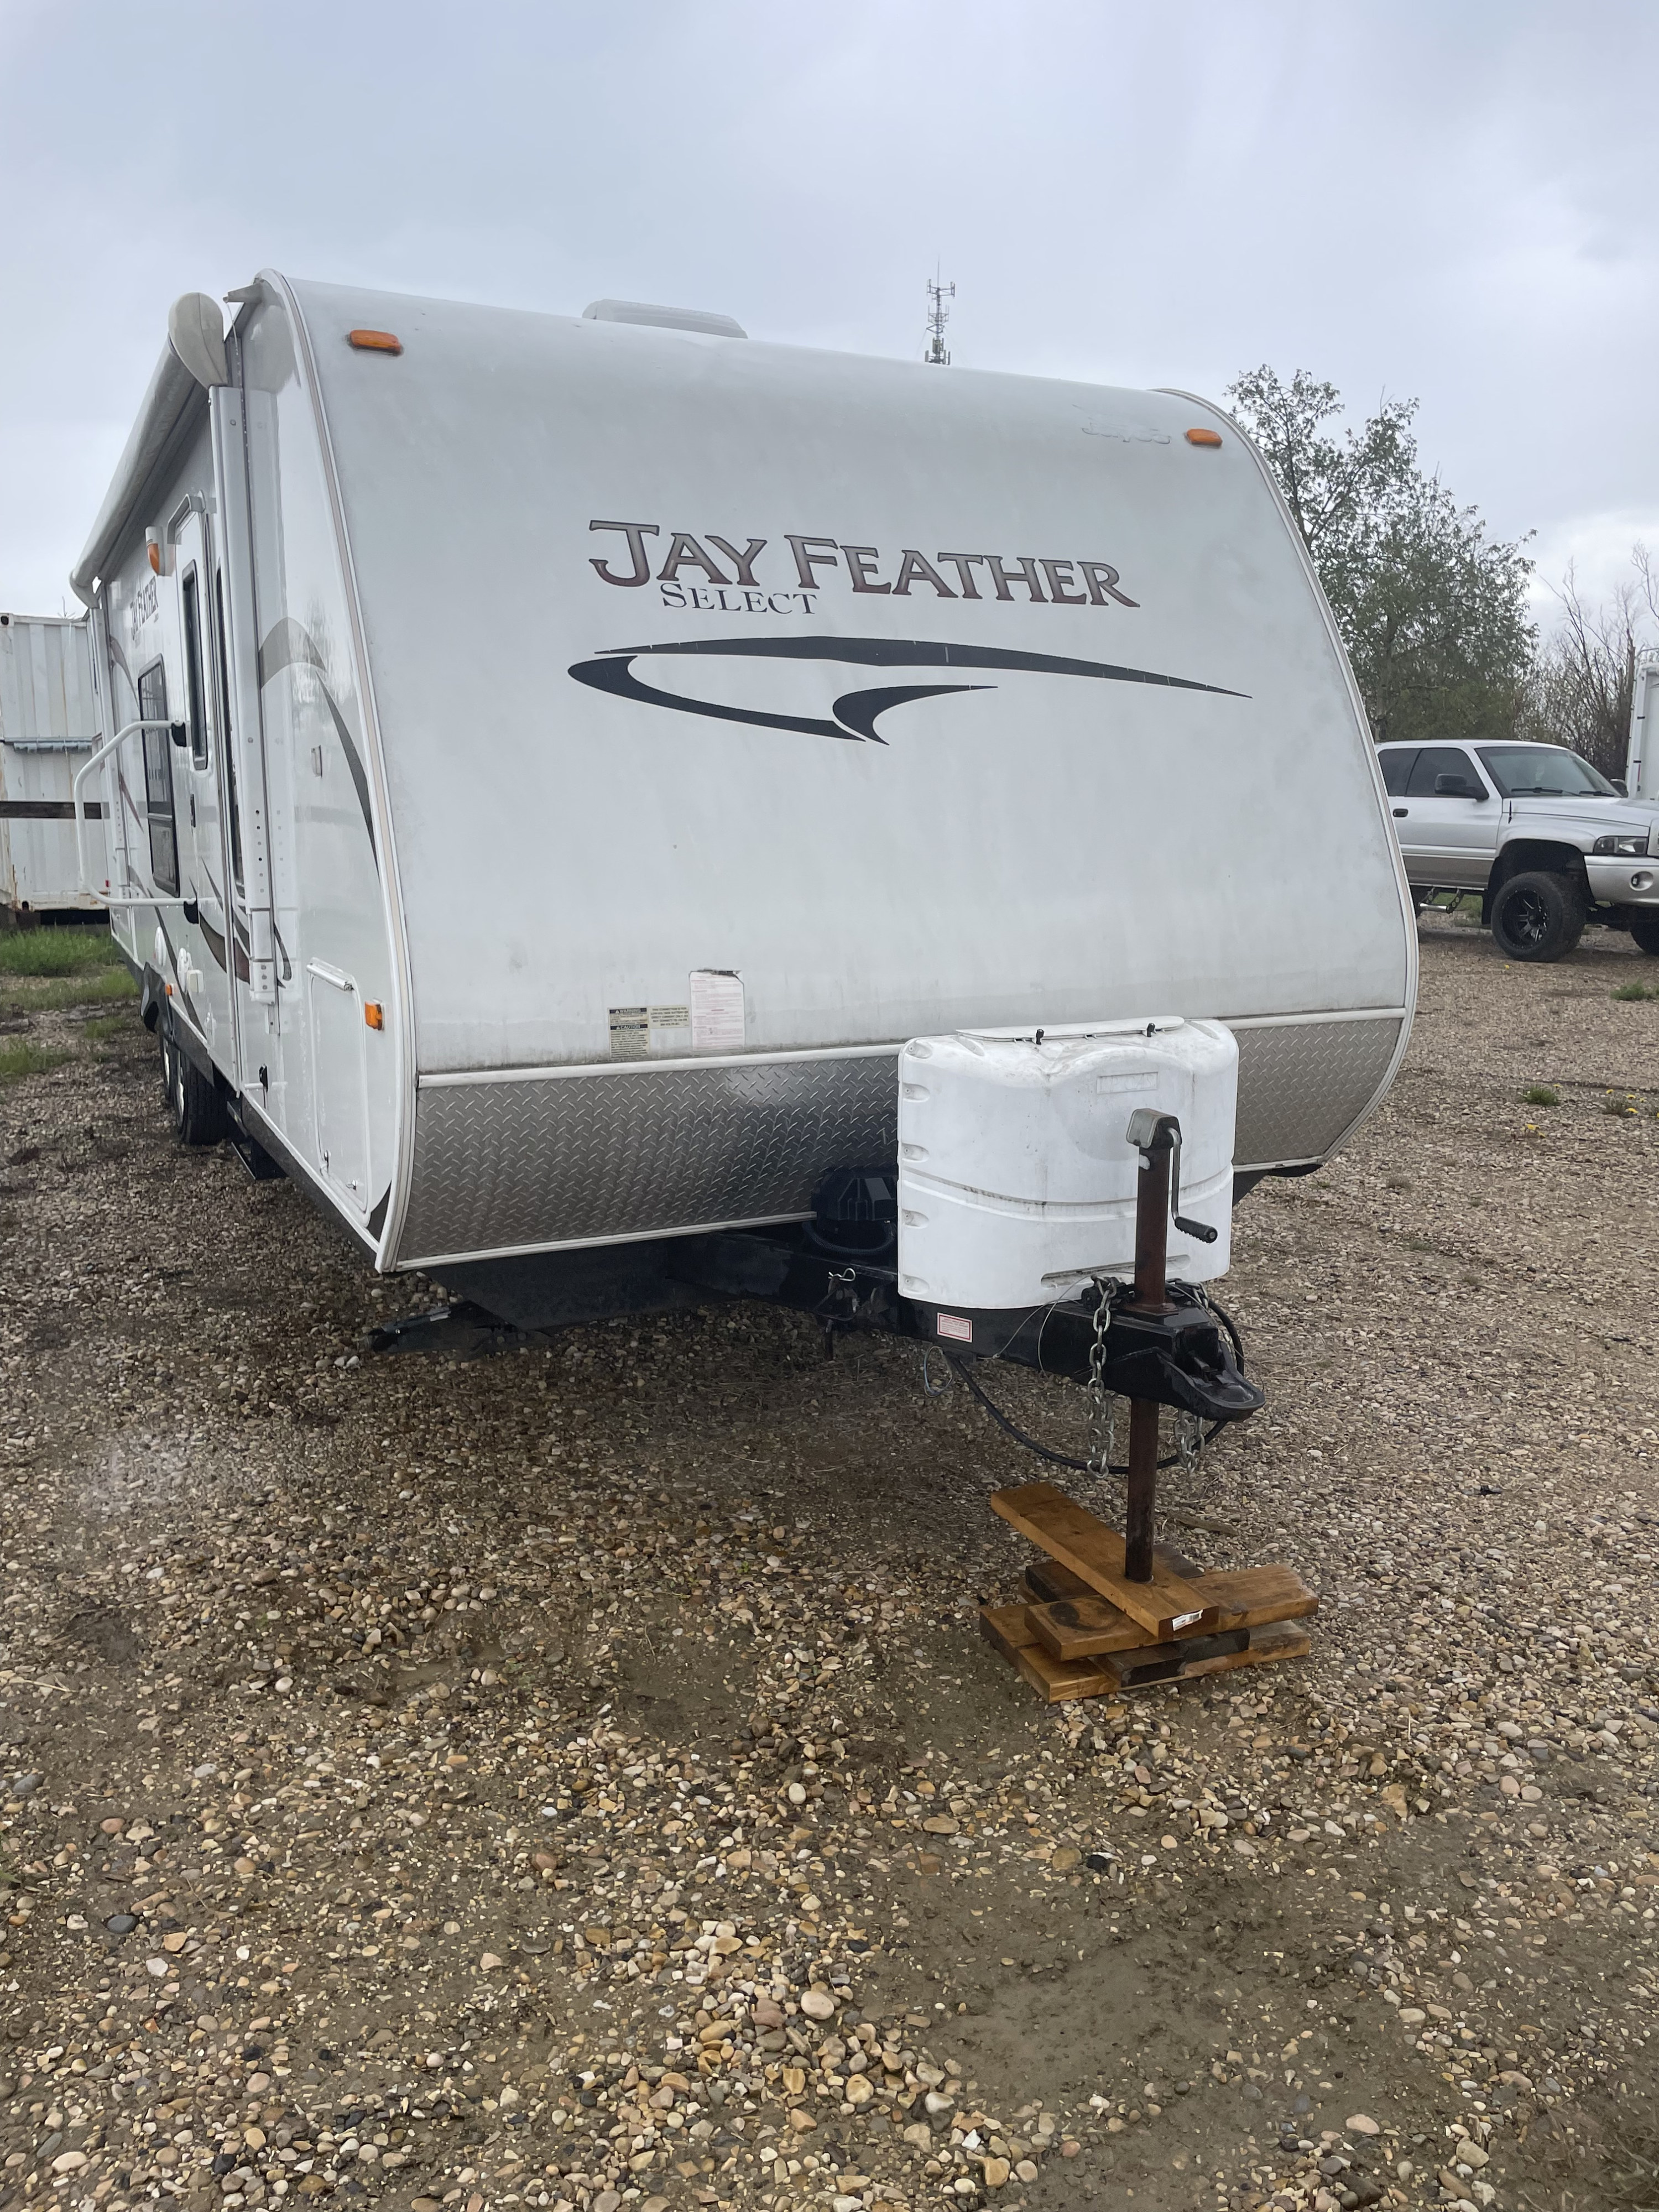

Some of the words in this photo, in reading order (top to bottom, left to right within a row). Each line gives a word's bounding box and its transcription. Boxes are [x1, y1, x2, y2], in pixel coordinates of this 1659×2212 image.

[588, 519, 768, 587] JAY
[784, 534, 1140, 608] FEATHER
[660, 582, 818, 614] SELECT
